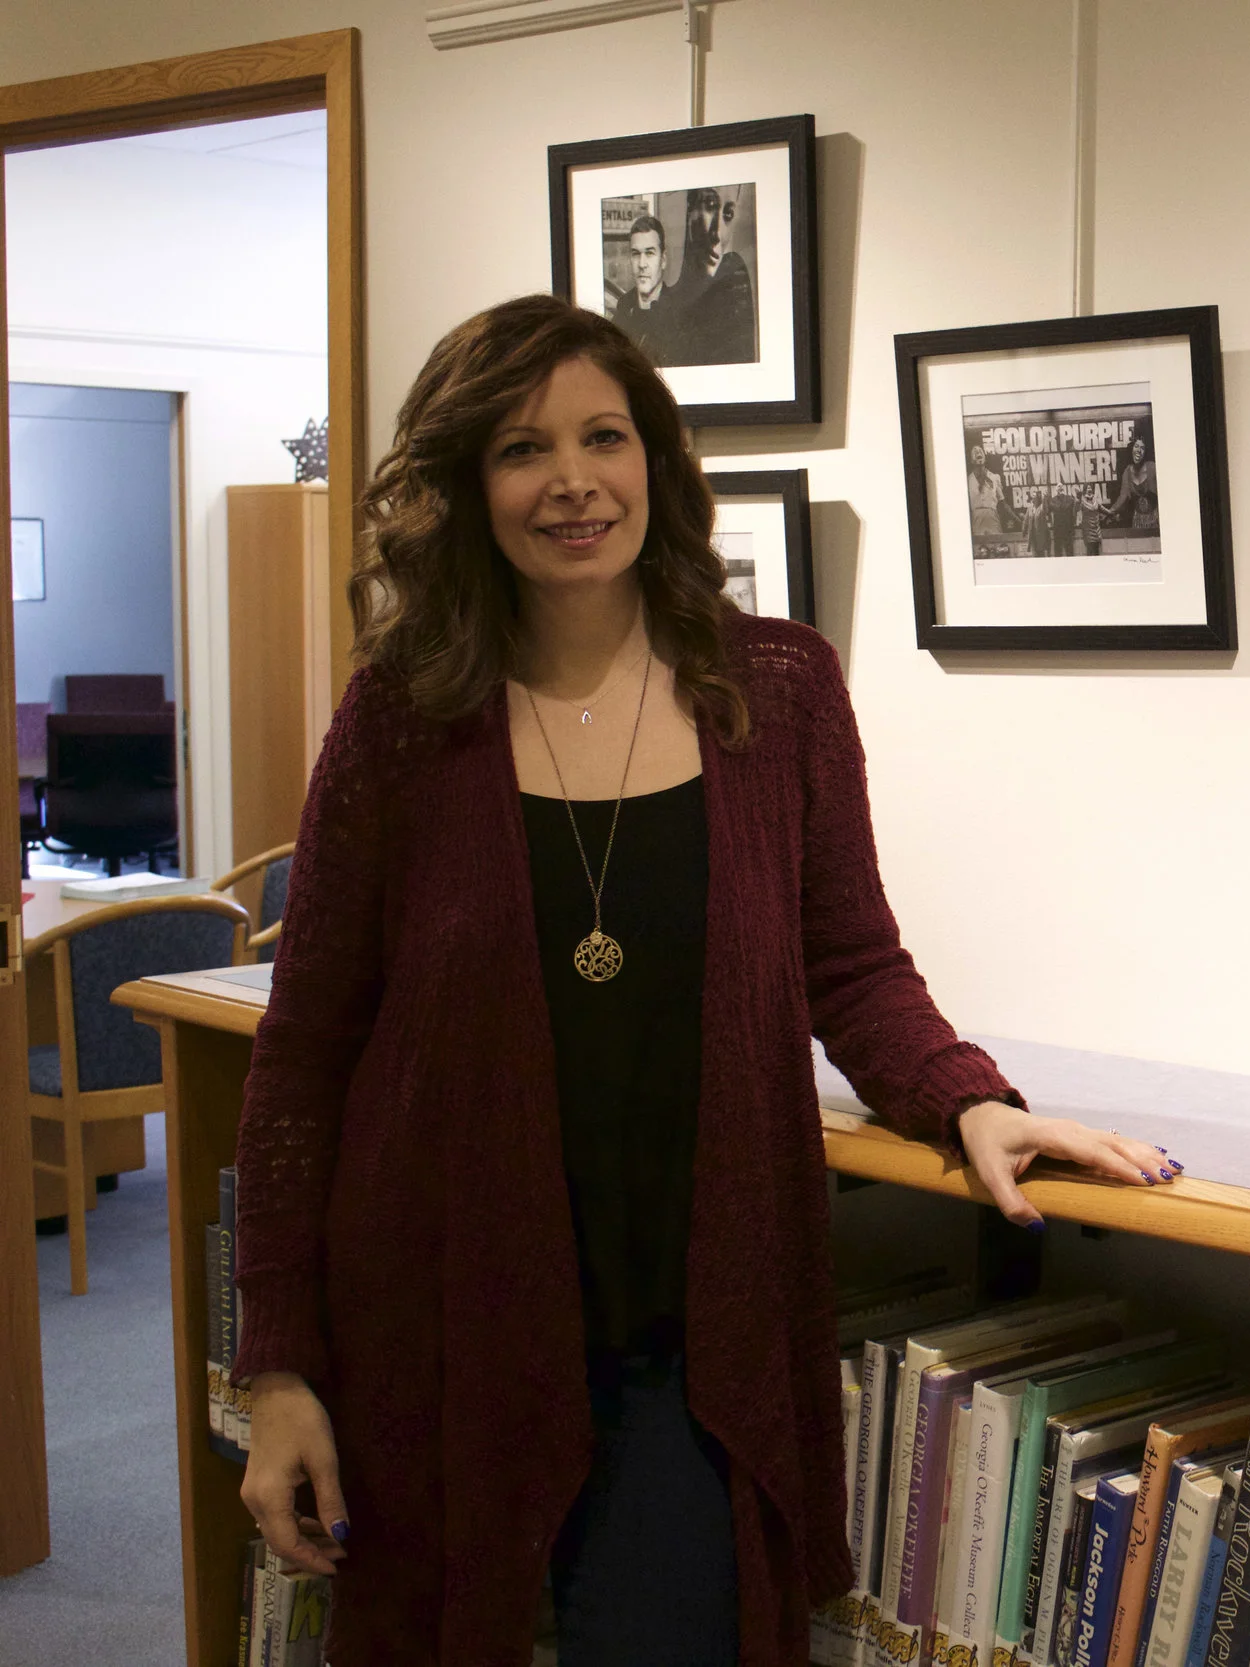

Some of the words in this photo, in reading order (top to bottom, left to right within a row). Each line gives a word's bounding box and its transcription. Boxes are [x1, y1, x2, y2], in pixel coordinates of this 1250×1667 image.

[993, 425, 1057, 455] COLOR
[1059, 420, 1135, 452] PURPLE
[1002, 455, 1027, 471] 2016
[1003, 471, 1028, 487] TONY
[1029, 449, 1118, 486] WINNER!
[865, 1356, 877, 1388] THE
[858, 1392, 872, 1459] GEORGIA
[910, 1402, 930, 1494] GEORGIA
[975, 1422, 993, 1474] Georgia
[969, 1477, 988, 1531] O'Keeffe
[1136, 1445, 1160, 1516] Howard
[1161, 1500, 1175, 1527] FAITH
[964, 1534, 984, 1588] Museum
[1085, 1522, 1109, 1617] Jackson
[1127, 1522, 1148, 1565] Pyle
[1150, 1528, 1169, 1599] RINGGOLD
[1158, 1519, 1192, 1633] LARRY
